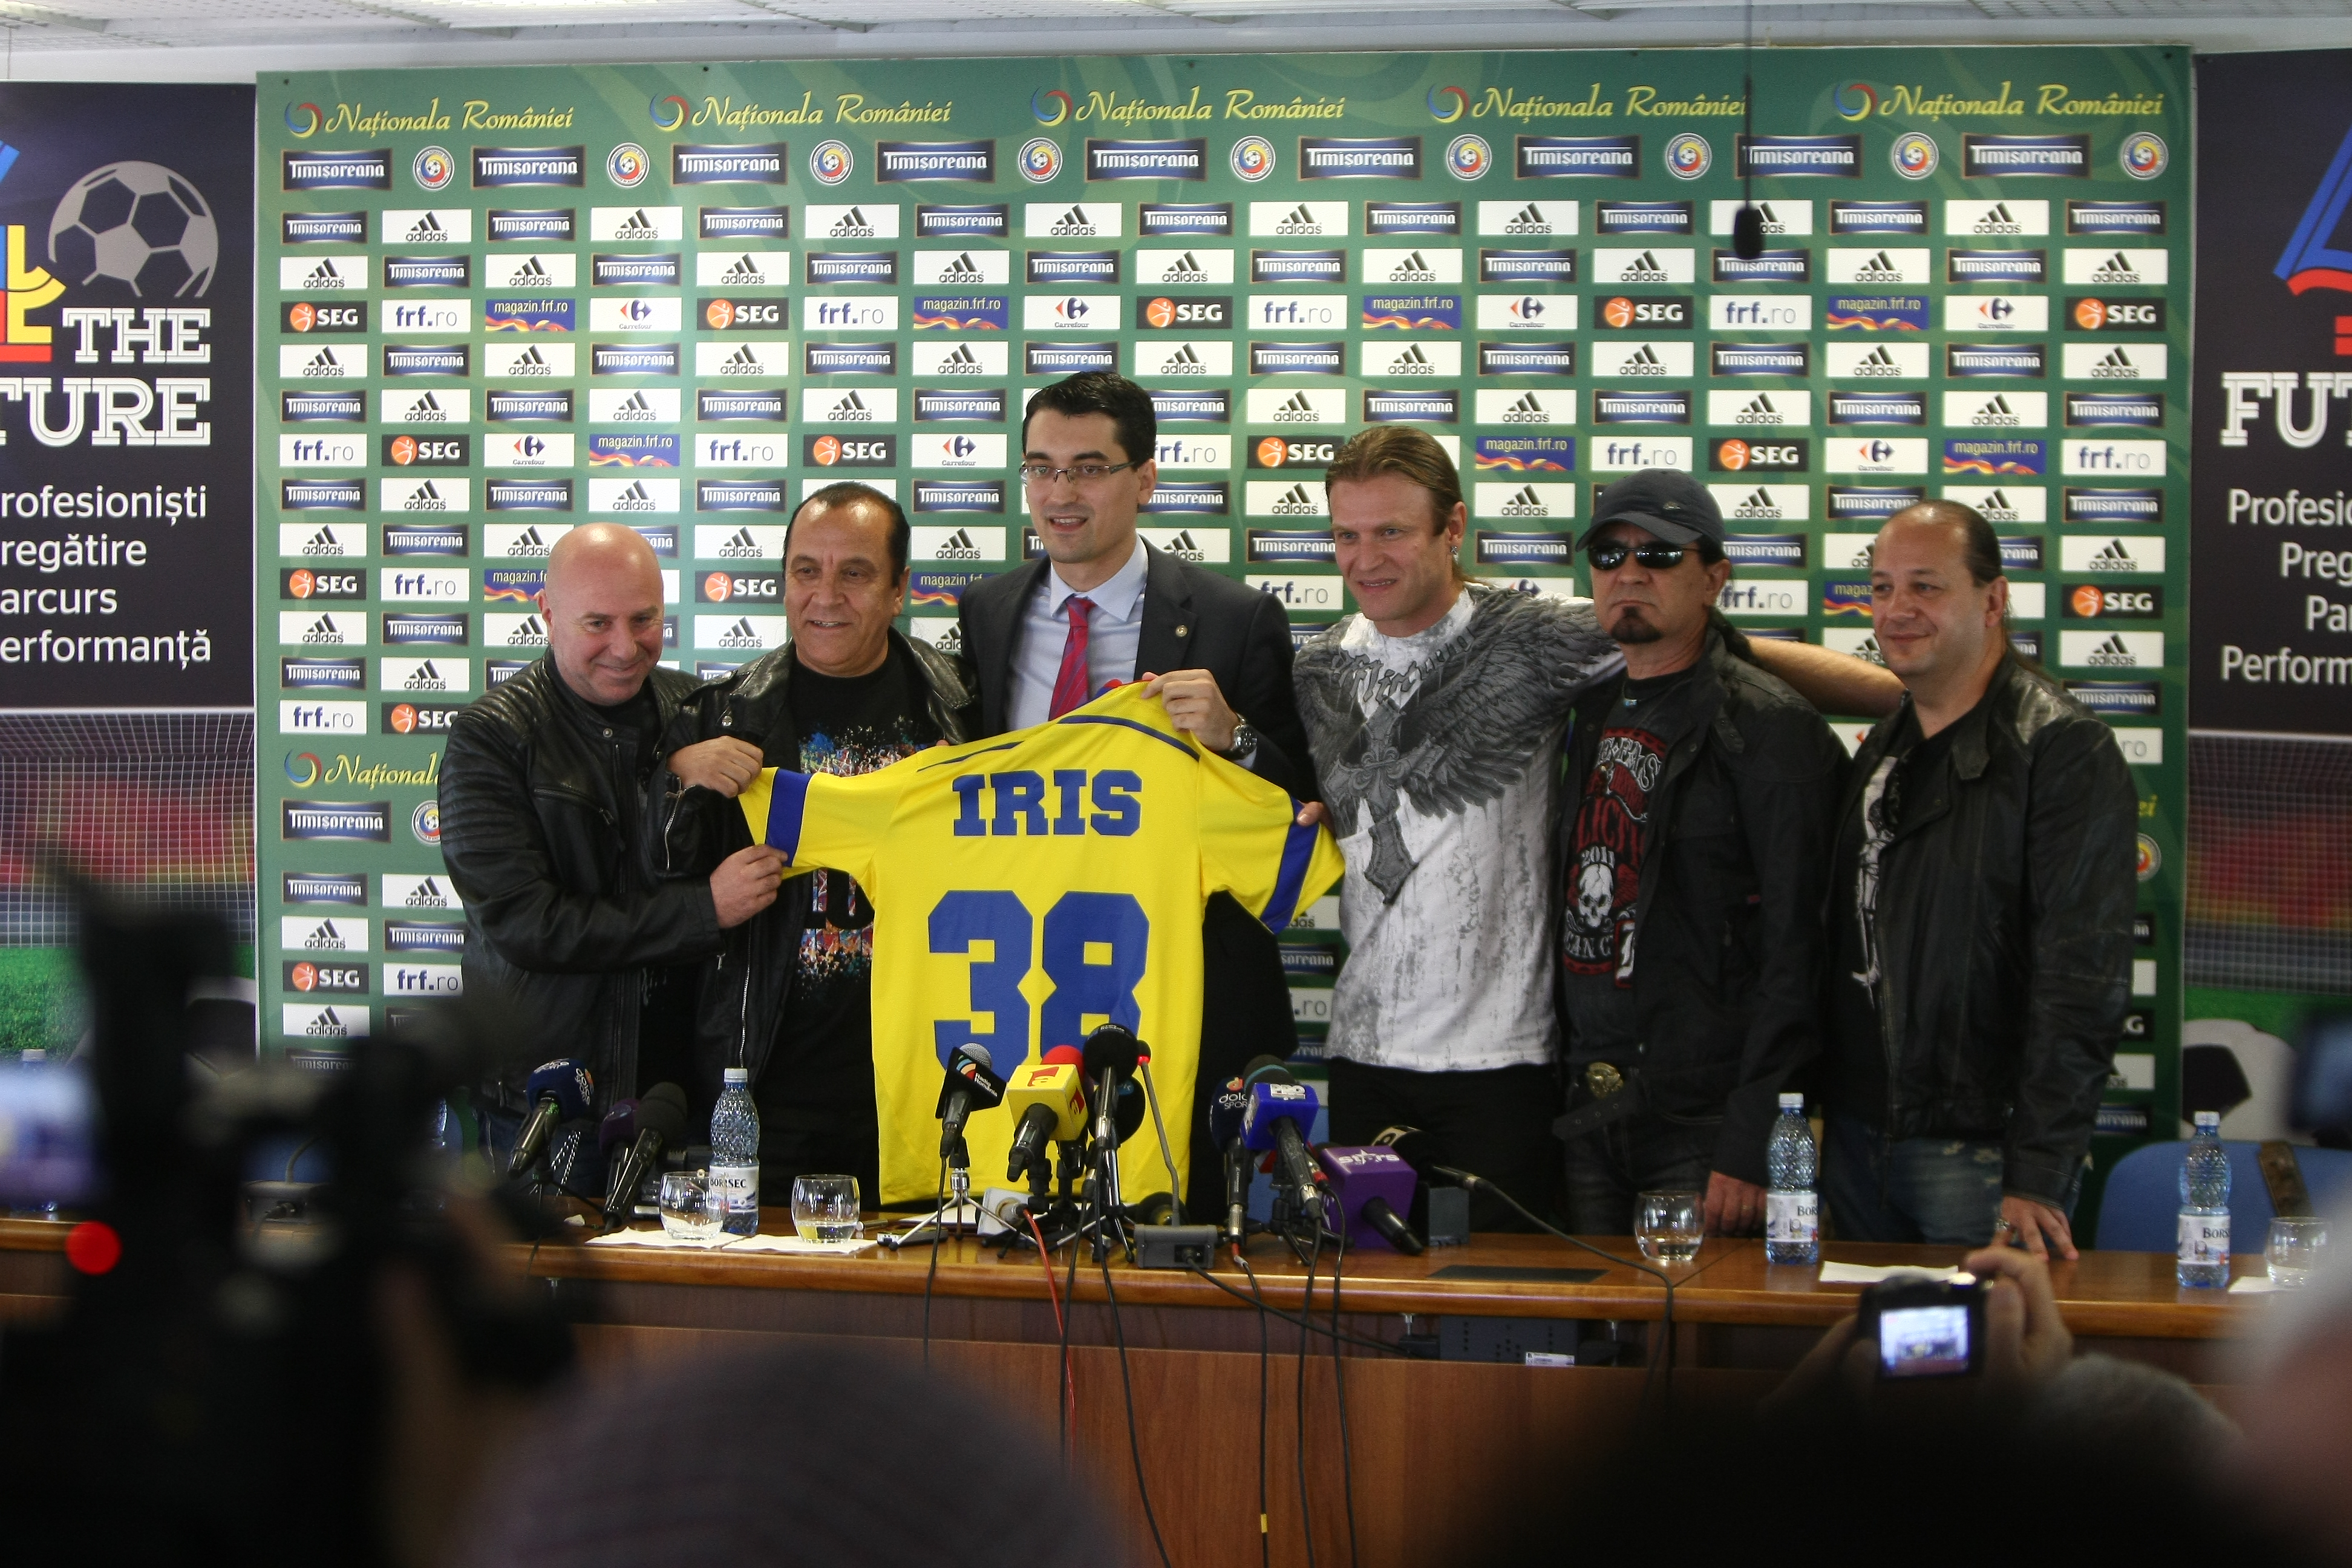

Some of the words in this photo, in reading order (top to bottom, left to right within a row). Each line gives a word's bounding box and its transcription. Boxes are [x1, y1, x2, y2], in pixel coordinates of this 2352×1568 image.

[1225, 88, 1344, 119] României
[1627, 85, 1745, 116] României
[2037, 83, 2163, 115] României
[462, 99, 573, 129] României
[836, 93, 950, 123] României
[406, 230, 448, 243] adidas
[615, 227, 658, 240] adidas
[830, 226, 875, 238] adidas
[1051, 224, 1096, 237] adidas
[1506, 222, 1552, 235] adidas
[304, 276, 345, 289] adidas
[509, 275, 552, 287] adidas
[936, 272, 985, 285] adidas
[1160, 271, 1209, 284] adidas
[1390, 270, 1436, 283] adidas
[494, 299, 568, 315] magazin.frf.ro
[818, 302, 883, 324] frf.ro
[923, 297, 1001, 313] magazin.frf.ro
[1177, 304, 1223, 321] SEG
[1264, 301, 1331, 323] frf.ro
[1636, 304, 1683, 321] SEG
[1725, 301, 1795, 324] frf.ro
[317, 309, 358, 325] SEG
[396, 305, 457, 327] frf.ro
[735, 305, 779, 323] SEG
[2107, 305, 2156, 323] SEG
[62, 307, 211, 363] THE
[301, 365, 345, 378] adidas
[509, 364, 551, 377] adidas
[1161, 362, 1206, 375] adidas
[1620, 363, 1666, 376] adidas
[405, 410, 446, 423] adidas
[612, 410, 656, 422] adidas
[1503, 410, 1549, 422] adidas
[598, 434, 673, 450] magazin.frf.ro
[710, 439, 773, 461] frf.ro
[293, 440, 353, 461] frf.ro
[419, 442, 460, 459] SEG
[842, 442, 886, 459] SEG
[1288, 443, 1334, 462] SEG
[1607, 443, 1676, 465] frf.ro
[1751, 446, 1798, 464] SEG
[2079, 446, 2151, 469] frf.ro
[402, 499, 446, 512] adidas
[610, 500, 658, 513] adidas
[1271, 503, 1318, 516] adidas
[1502, 505, 1548, 517] adidas
[1, 533, 146, 573] regătire
[302, 544, 344, 557] adidas
[507, 545, 552, 558] adidas
[718, 546, 764, 559] adidas
[936, 547, 981, 560] adidas
[316, 575, 357, 593] SEG
[394, 573, 456, 595] frf.ro
[734, 578, 777, 596] SEG
[0, 589, 117, 614] arcurs
[2104, 592, 2153, 611] SEG
[302, 632, 344, 645] adidas
[718, 637, 765, 650] adidas
[405, 678, 446, 691] adidas
[293, 706, 353, 728] frf.ro
[953, 769, 1142, 836] IRIS
[406, 895, 446, 907] adidas
[305, 937, 345, 950] adidas
[319, 970, 359, 986] SEG
[397, 970, 459, 991] frf.ro
[928, 890, 1150, 1082] 38
[307, 1024, 348, 1036] adidas
[1219, 1092, 1247, 1103] dolc
[1224, 1101, 1248, 1109] SPOR
[1797, 1205, 1818, 1217] BOR
